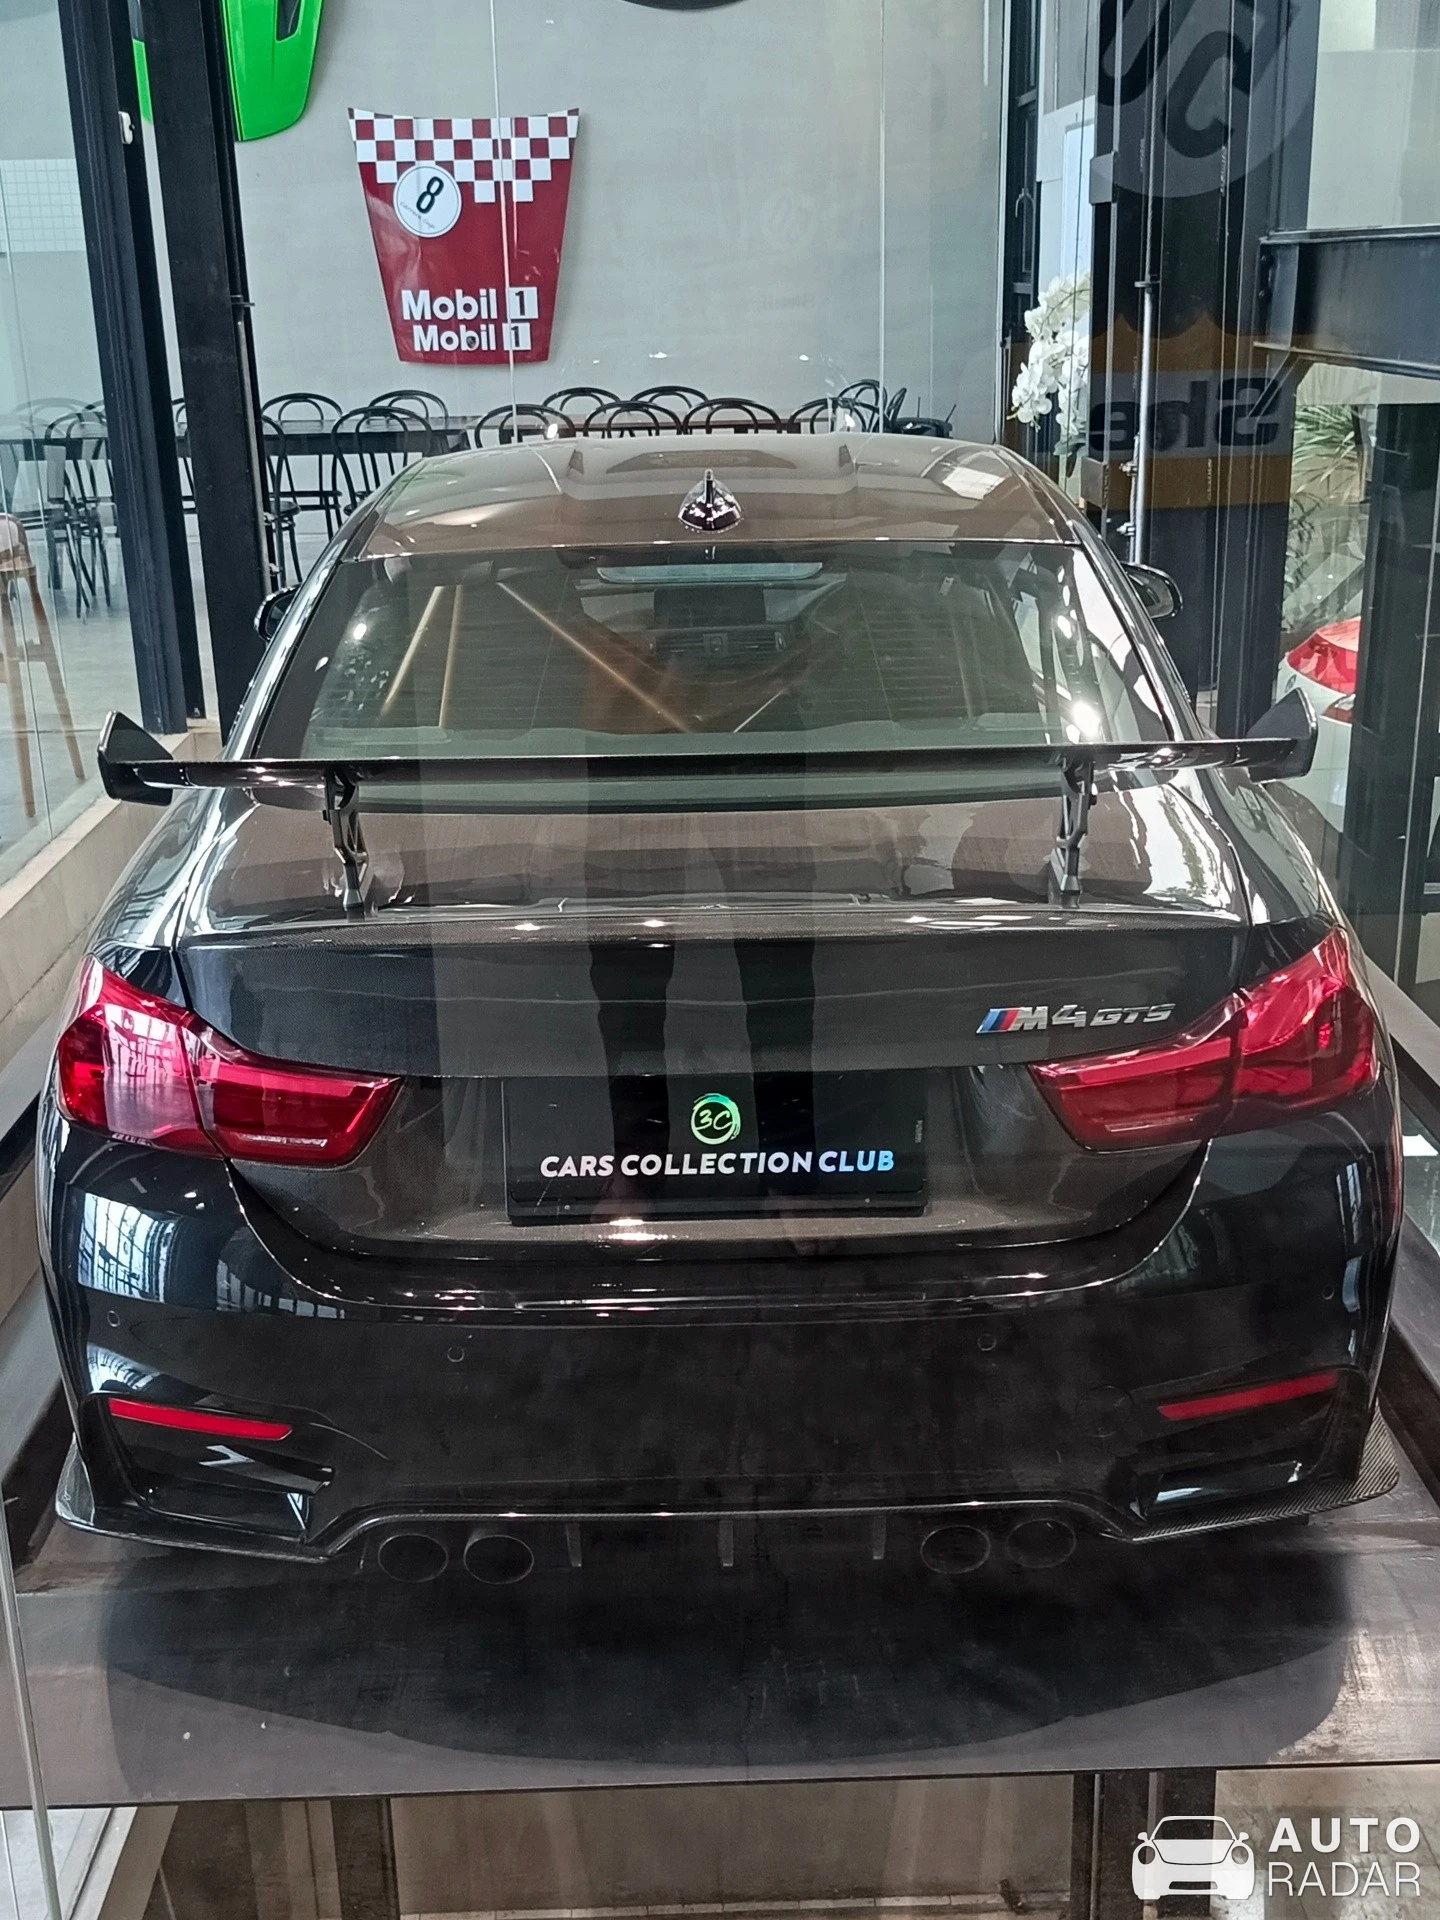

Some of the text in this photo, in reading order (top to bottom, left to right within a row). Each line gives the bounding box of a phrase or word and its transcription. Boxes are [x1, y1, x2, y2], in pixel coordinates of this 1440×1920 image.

[416, 176, 444, 214] 8
[401, 288, 498, 321] Mobil
[413, 324, 497, 352] Mobil
[1090, 1003, 1176, 1026] GTS
[540, 1150, 895, 1178] CARS COLLECTION CLUB
